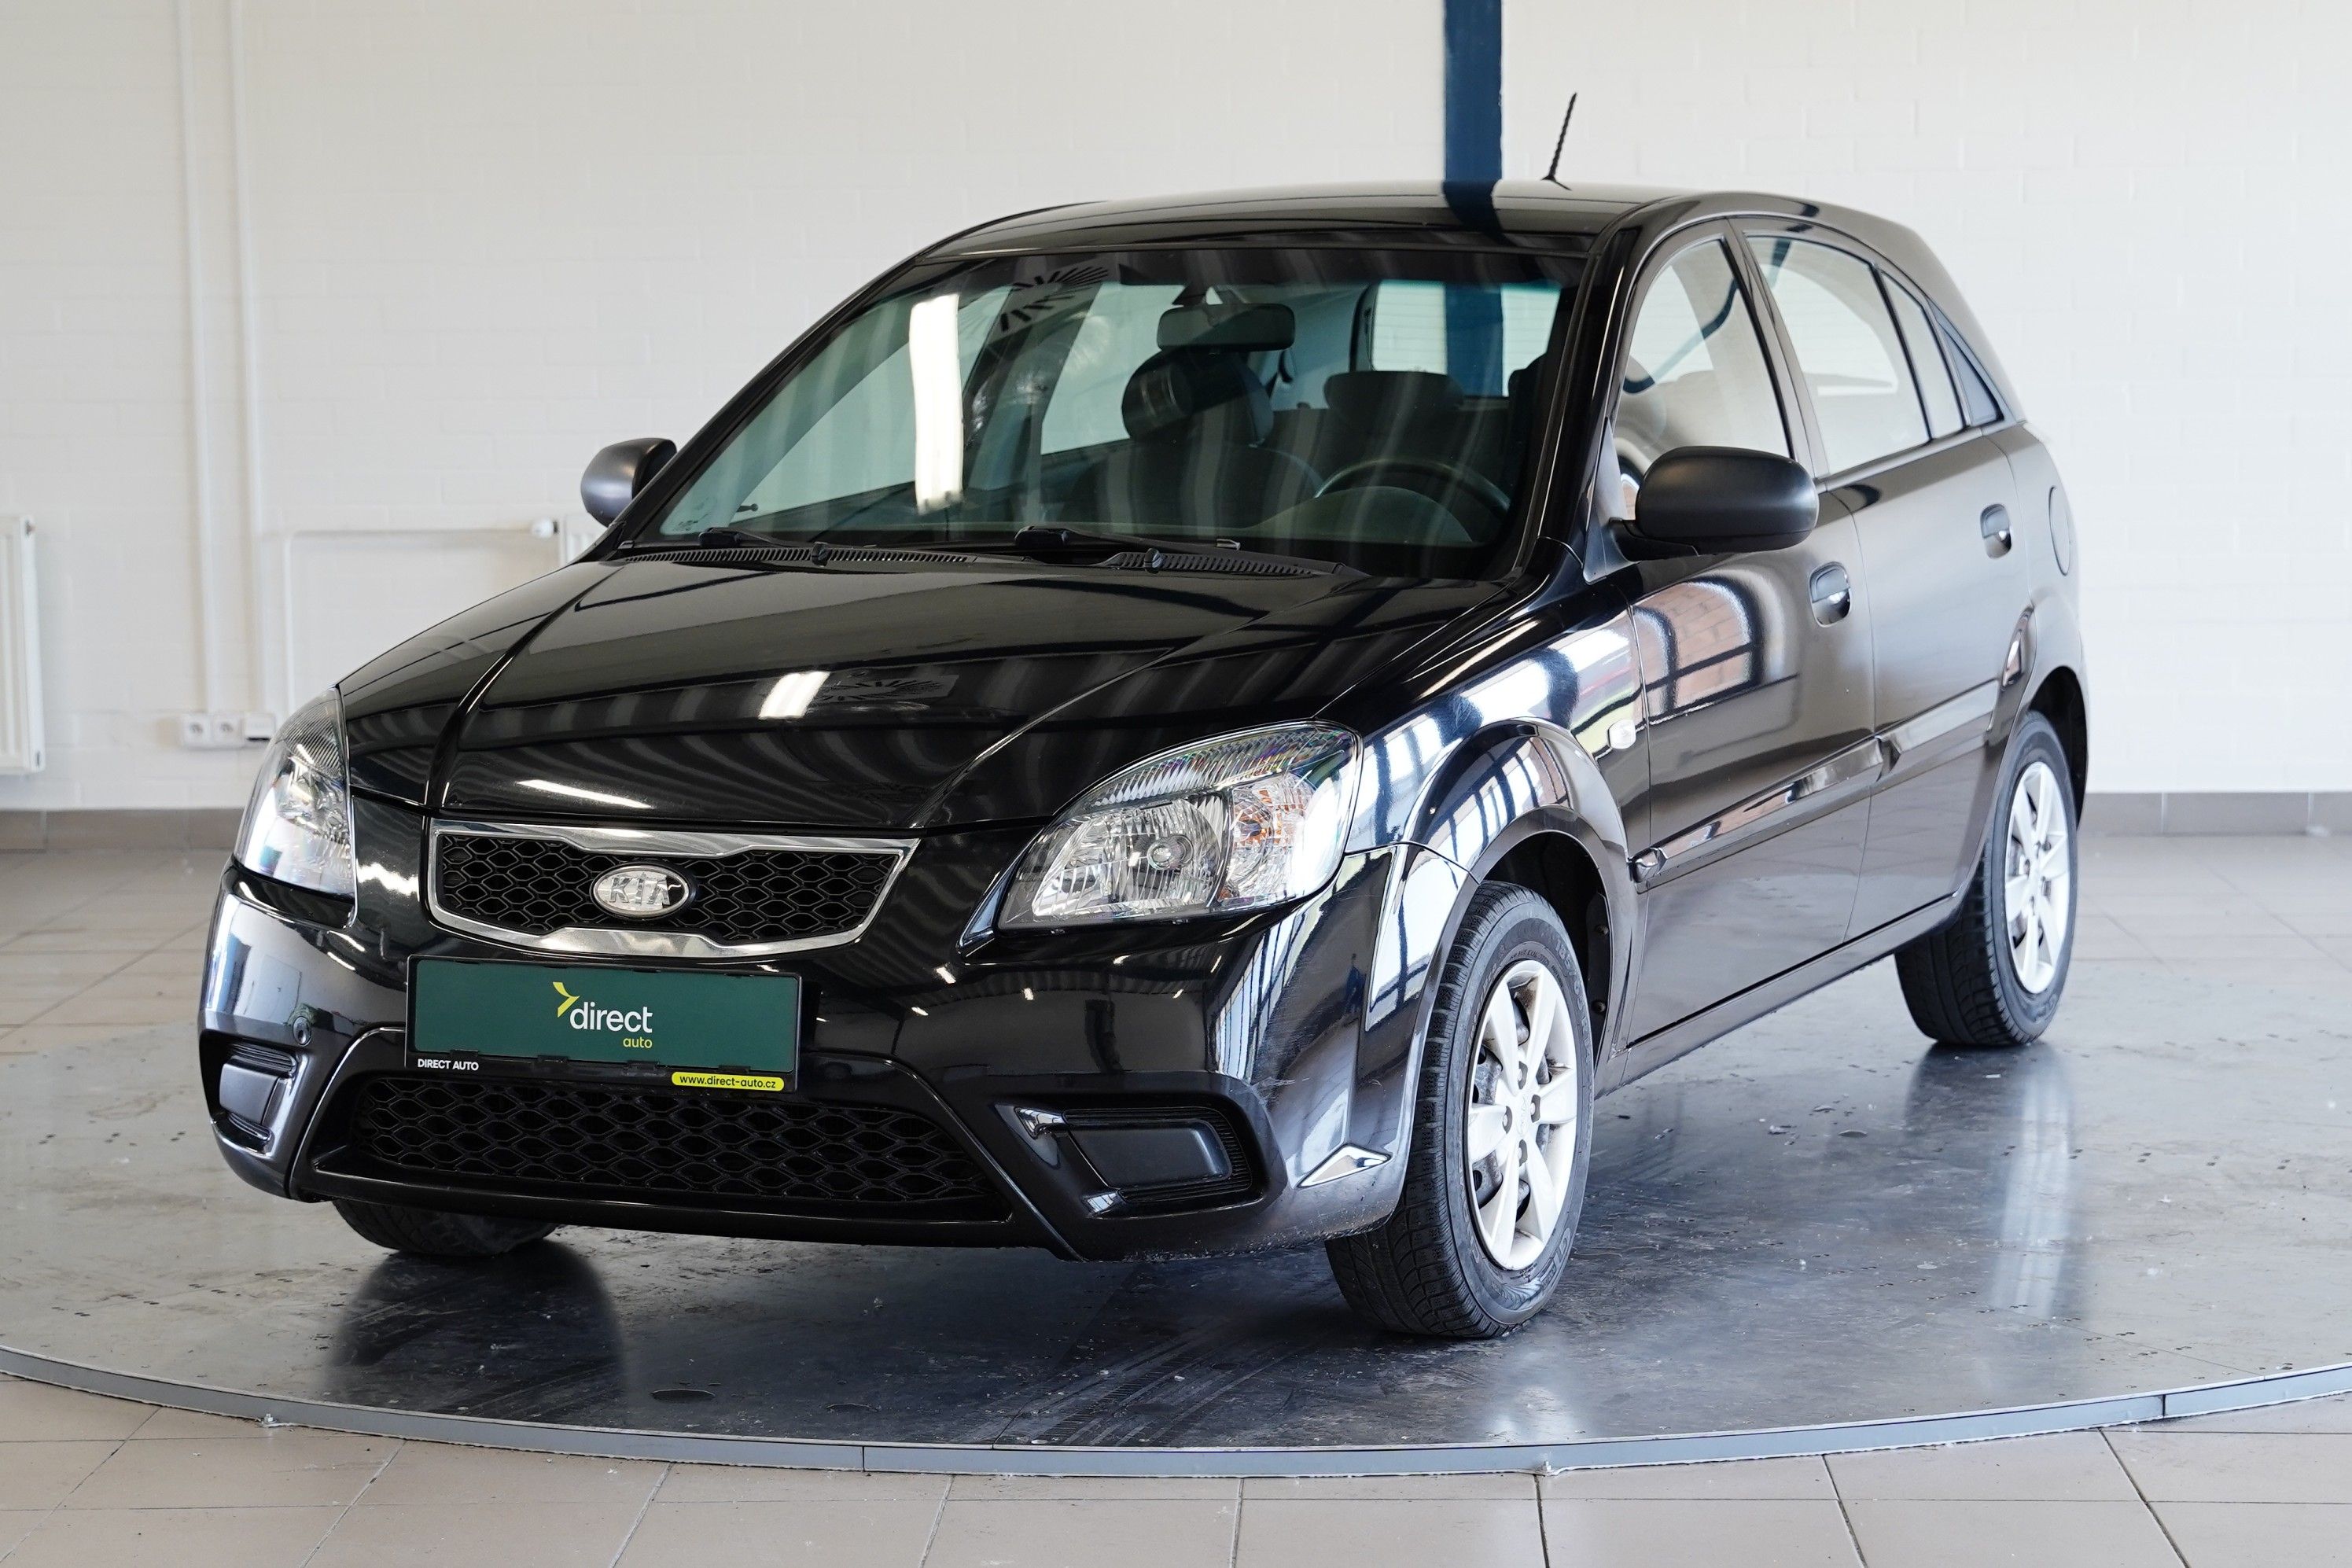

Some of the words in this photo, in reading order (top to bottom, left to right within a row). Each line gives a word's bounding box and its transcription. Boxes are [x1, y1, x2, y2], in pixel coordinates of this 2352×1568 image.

[609, 875, 670, 906] KIA
[569, 1001, 653, 1033] direct
[622, 1036, 653, 1049] auto
[418, 1058, 451, 1069] DIRECT
[452, 1061, 479, 1071] AUTO
[679, 1075, 776, 1088] www.direct-auto.cz
